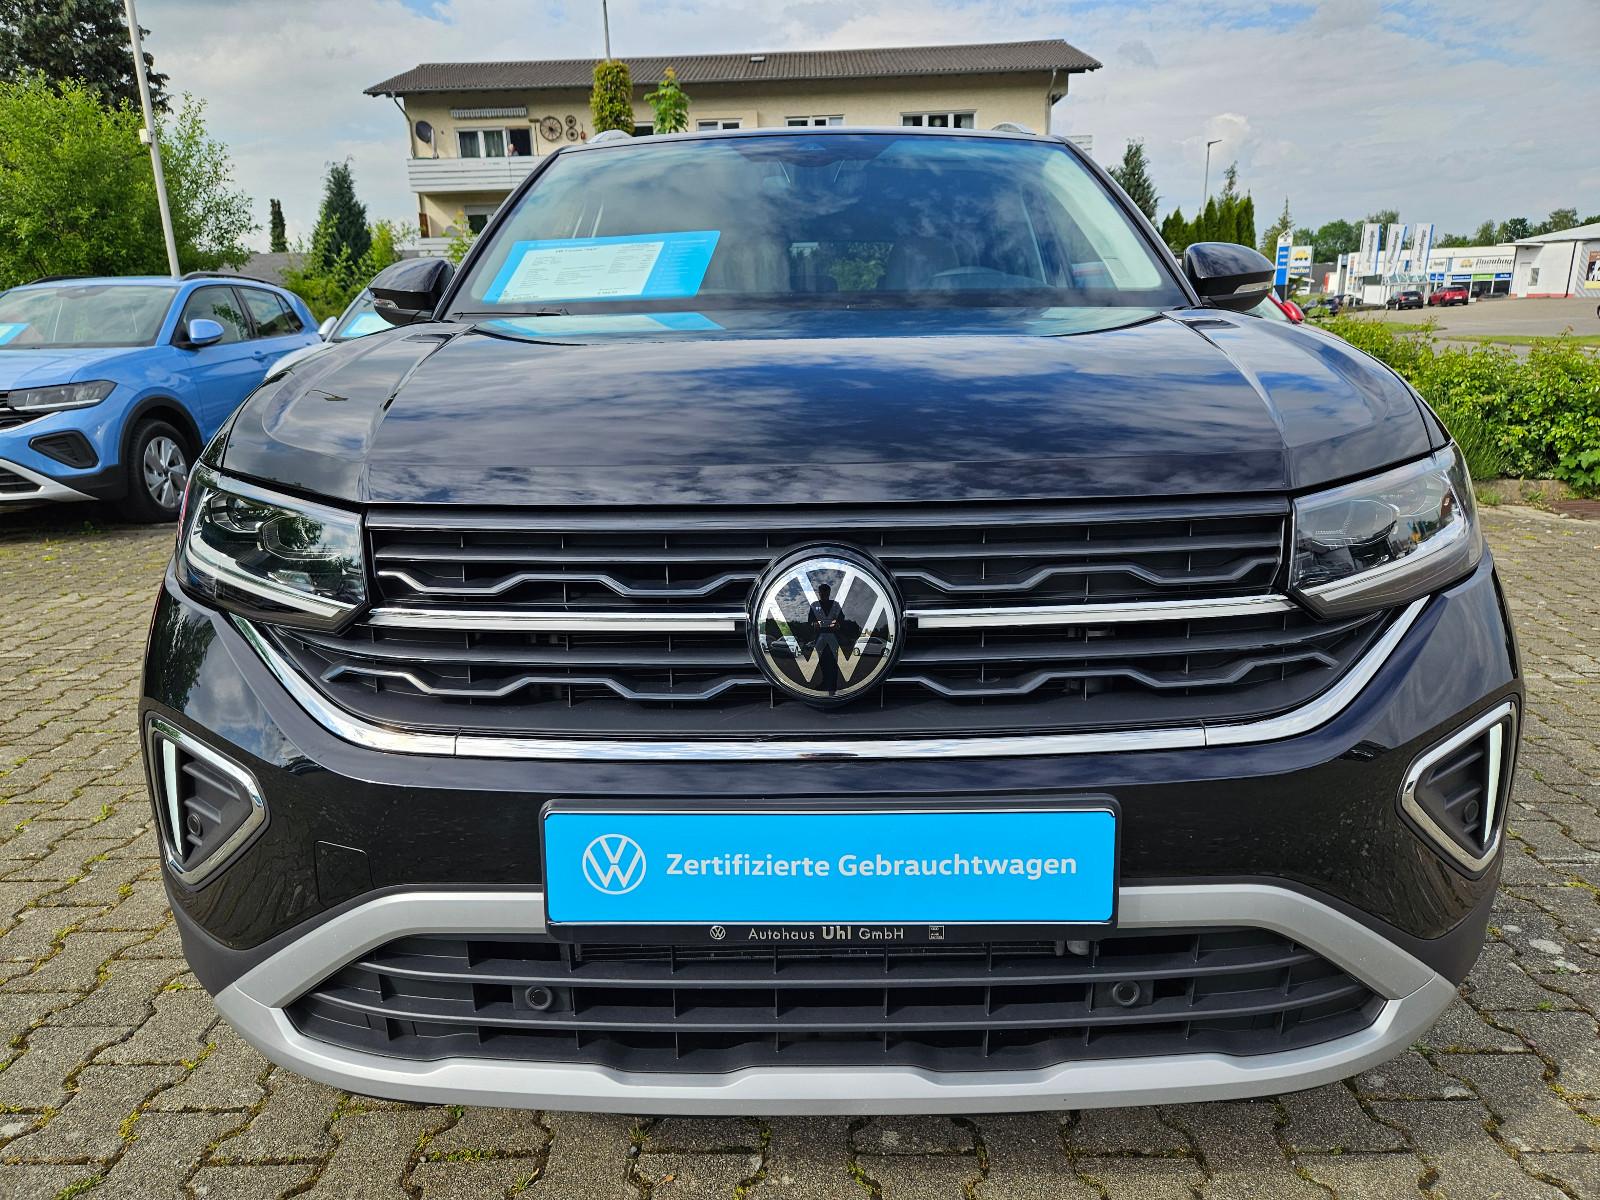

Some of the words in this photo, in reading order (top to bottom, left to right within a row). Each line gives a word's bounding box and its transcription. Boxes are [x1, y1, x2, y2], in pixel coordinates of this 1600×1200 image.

[666, 853, 830, 876] Zertifizierte
[838, 853, 1077, 880] Gebrauchtwagen
[748, 927, 815, 940] Autohaus
[822, 925, 852, 940] Uhl
[858, 927, 904, 940] GmbH
